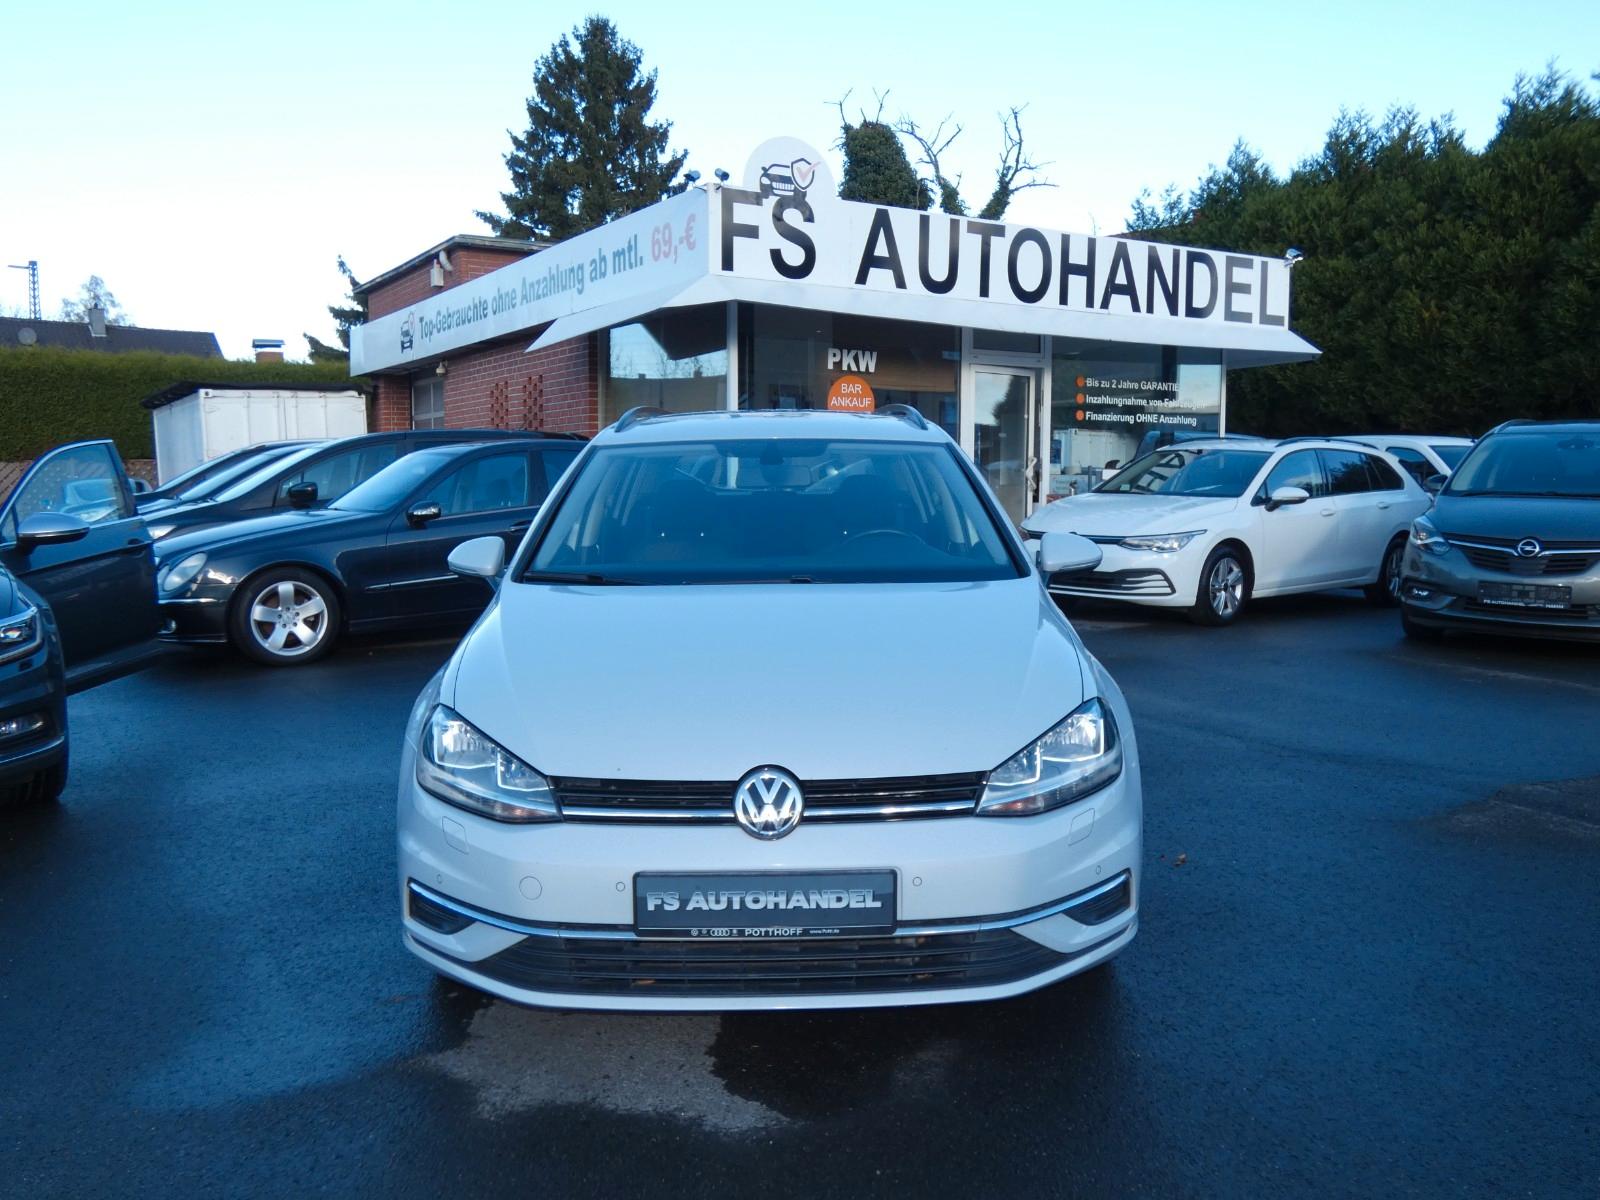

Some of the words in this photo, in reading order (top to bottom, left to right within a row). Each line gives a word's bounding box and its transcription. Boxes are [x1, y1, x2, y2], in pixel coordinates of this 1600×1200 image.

[720, 187, 817, 280] FS
[854, 207, 1286, 327] AUTOHANDEL
[418, 295, 489, 342] Top-Gebrauchte
[491, 287, 517, 316] ohne
[520, 262, 585, 306] Anzahlung
[589, 247, 608, 282] ab
[612, 233, 644, 274] mtl.
[651, 213, 697, 264] 69,-€
[827, 347, 878, 373] PKW
[841, 383, 862, 394] BAR
[1086, 378, 1099, 387] Bis
[1100, 380, 1110, 388] zu
[1111, 379, 1117, 388] 2
[1118, 380, 1139, 389] Jahre
[1140, 382, 1180, 392] GARANTIE
[830, 396, 872, 408] ANKAUF
[1086, 395, 1147, 407] Inzahlungnahme
[1086, 411, 1135, 424] Finanzierung
[1136, 414, 1158, 423] OHNE
[1159, 415, 1197, 427] Anzahlung
[646, 891, 680, 911] FS
[686, 889, 882, 911] AUTOHANDEL
[744, 927, 803, 937] POTTHOFF
